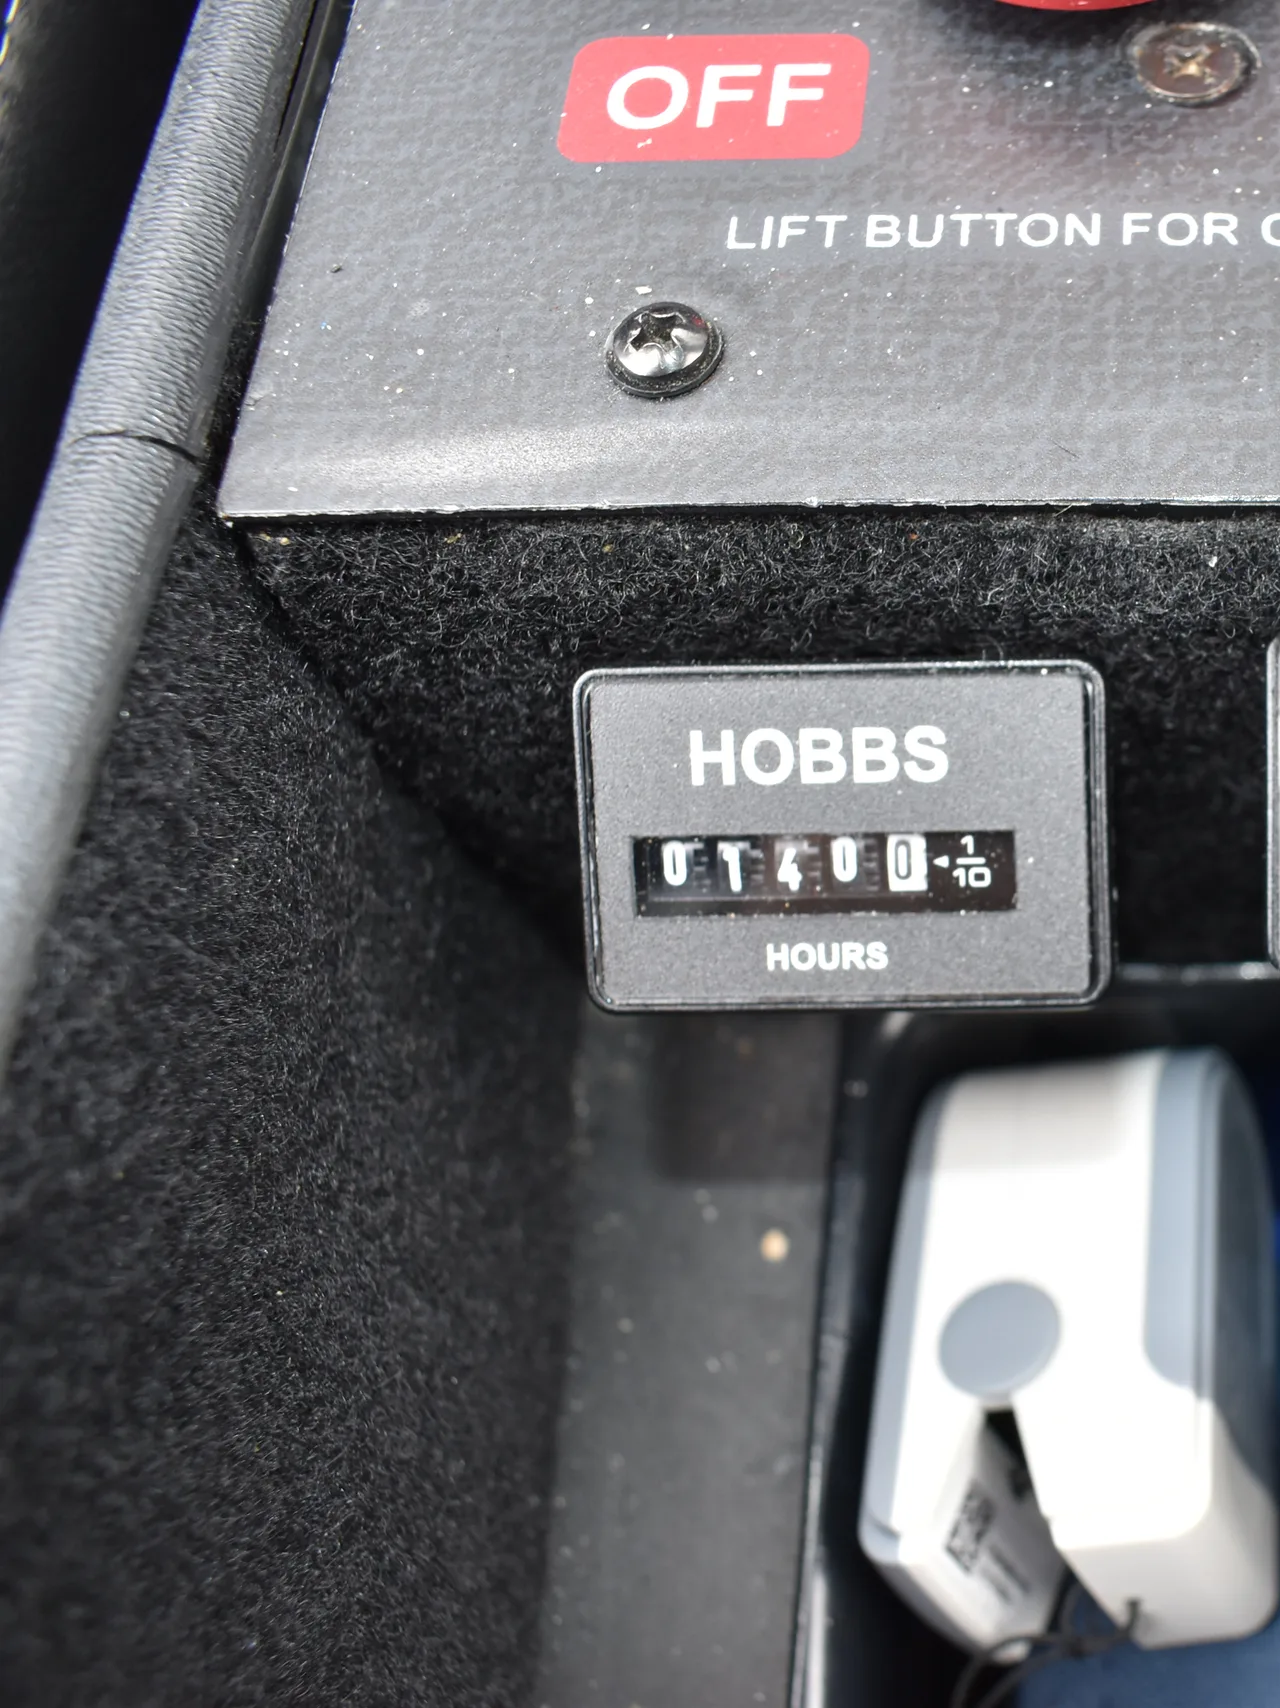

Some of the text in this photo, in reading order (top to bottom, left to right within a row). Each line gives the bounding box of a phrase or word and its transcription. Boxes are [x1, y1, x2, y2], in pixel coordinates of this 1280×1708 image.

[606, 63, 833, 130] OFF
[724, 214, 849, 250] LIFT
[865, 212, 1102, 249] BUTTON
[1122, 212, 1239, 247] FOR
[688, 725, 949, 787] HOBBS
[766, 941, 889, 972] HOURS
